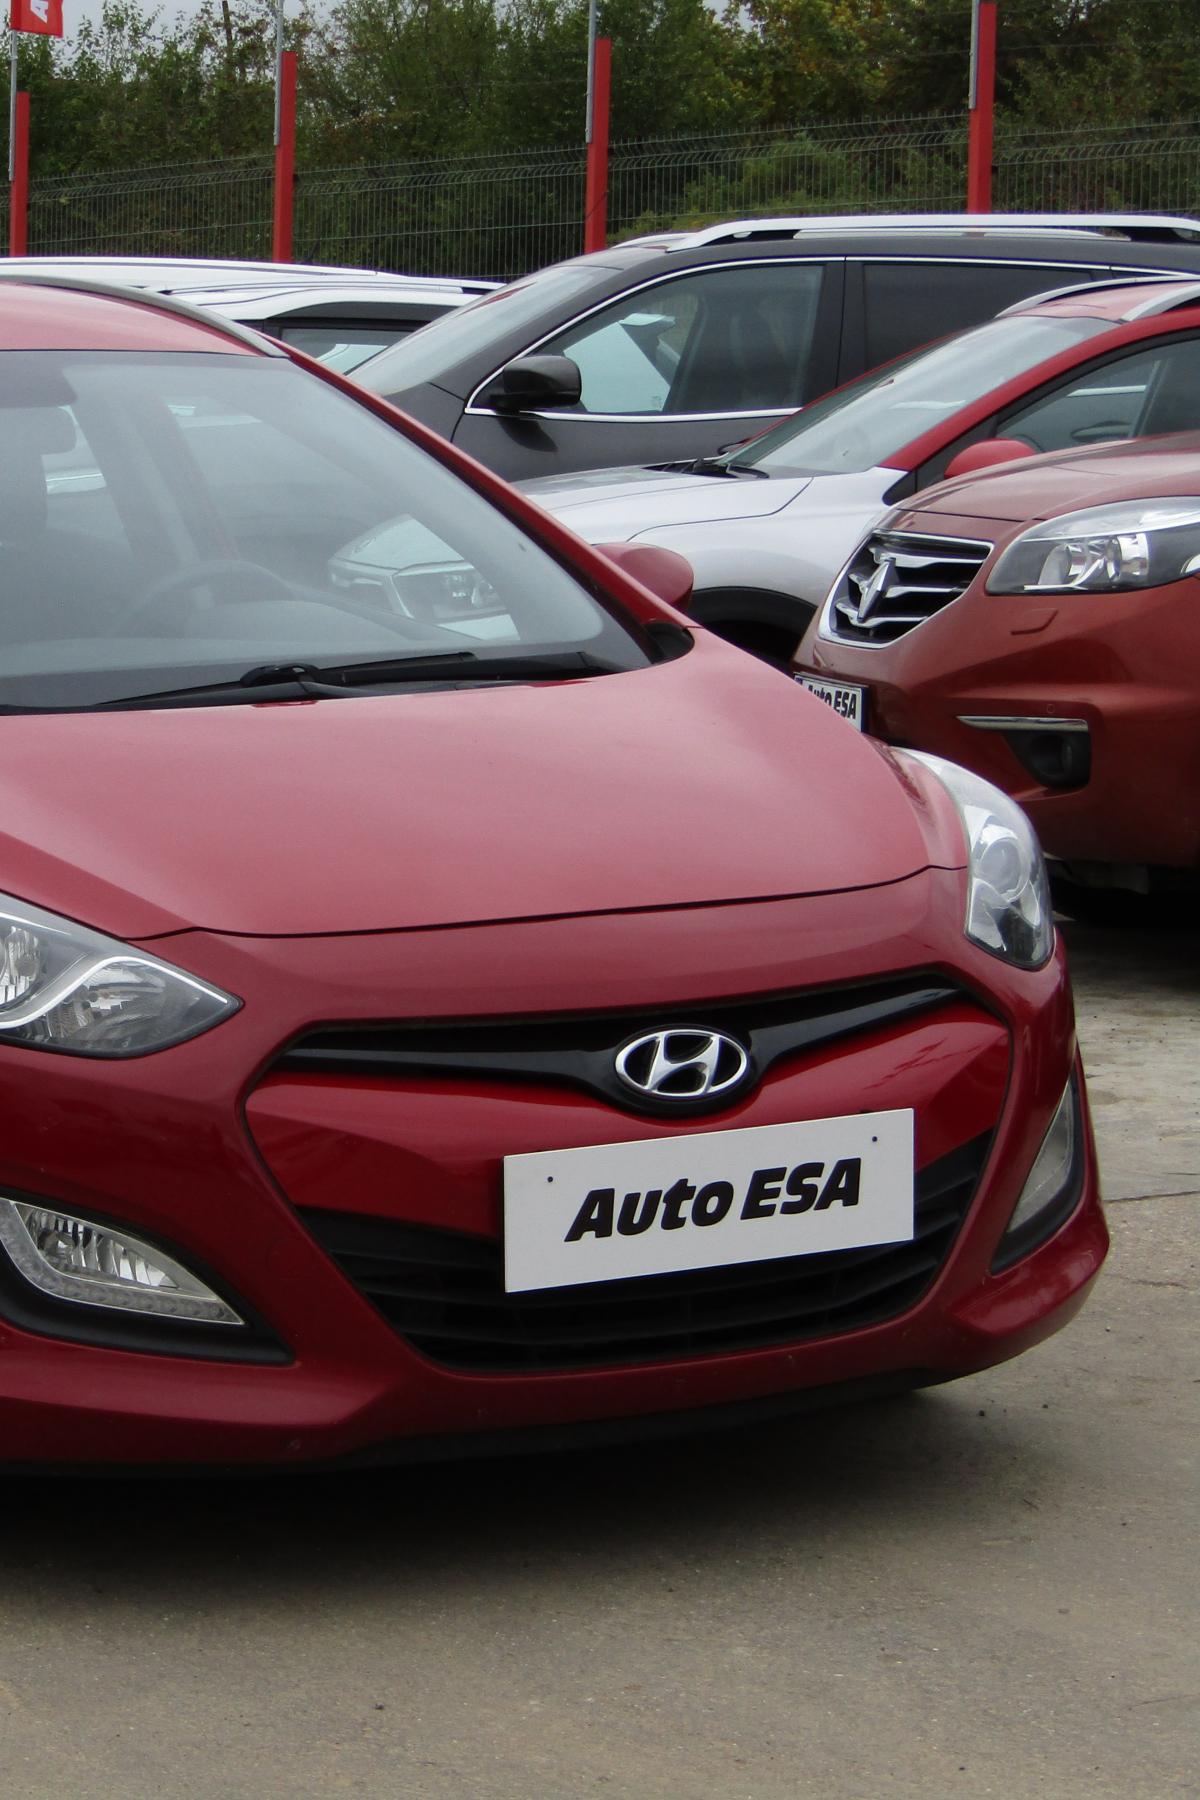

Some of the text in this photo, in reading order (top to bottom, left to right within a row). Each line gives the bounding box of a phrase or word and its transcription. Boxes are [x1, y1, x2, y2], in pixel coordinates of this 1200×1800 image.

[833, 690, 857, 719] ESA
[564, 1157, 861, 1242] Auto ESA
